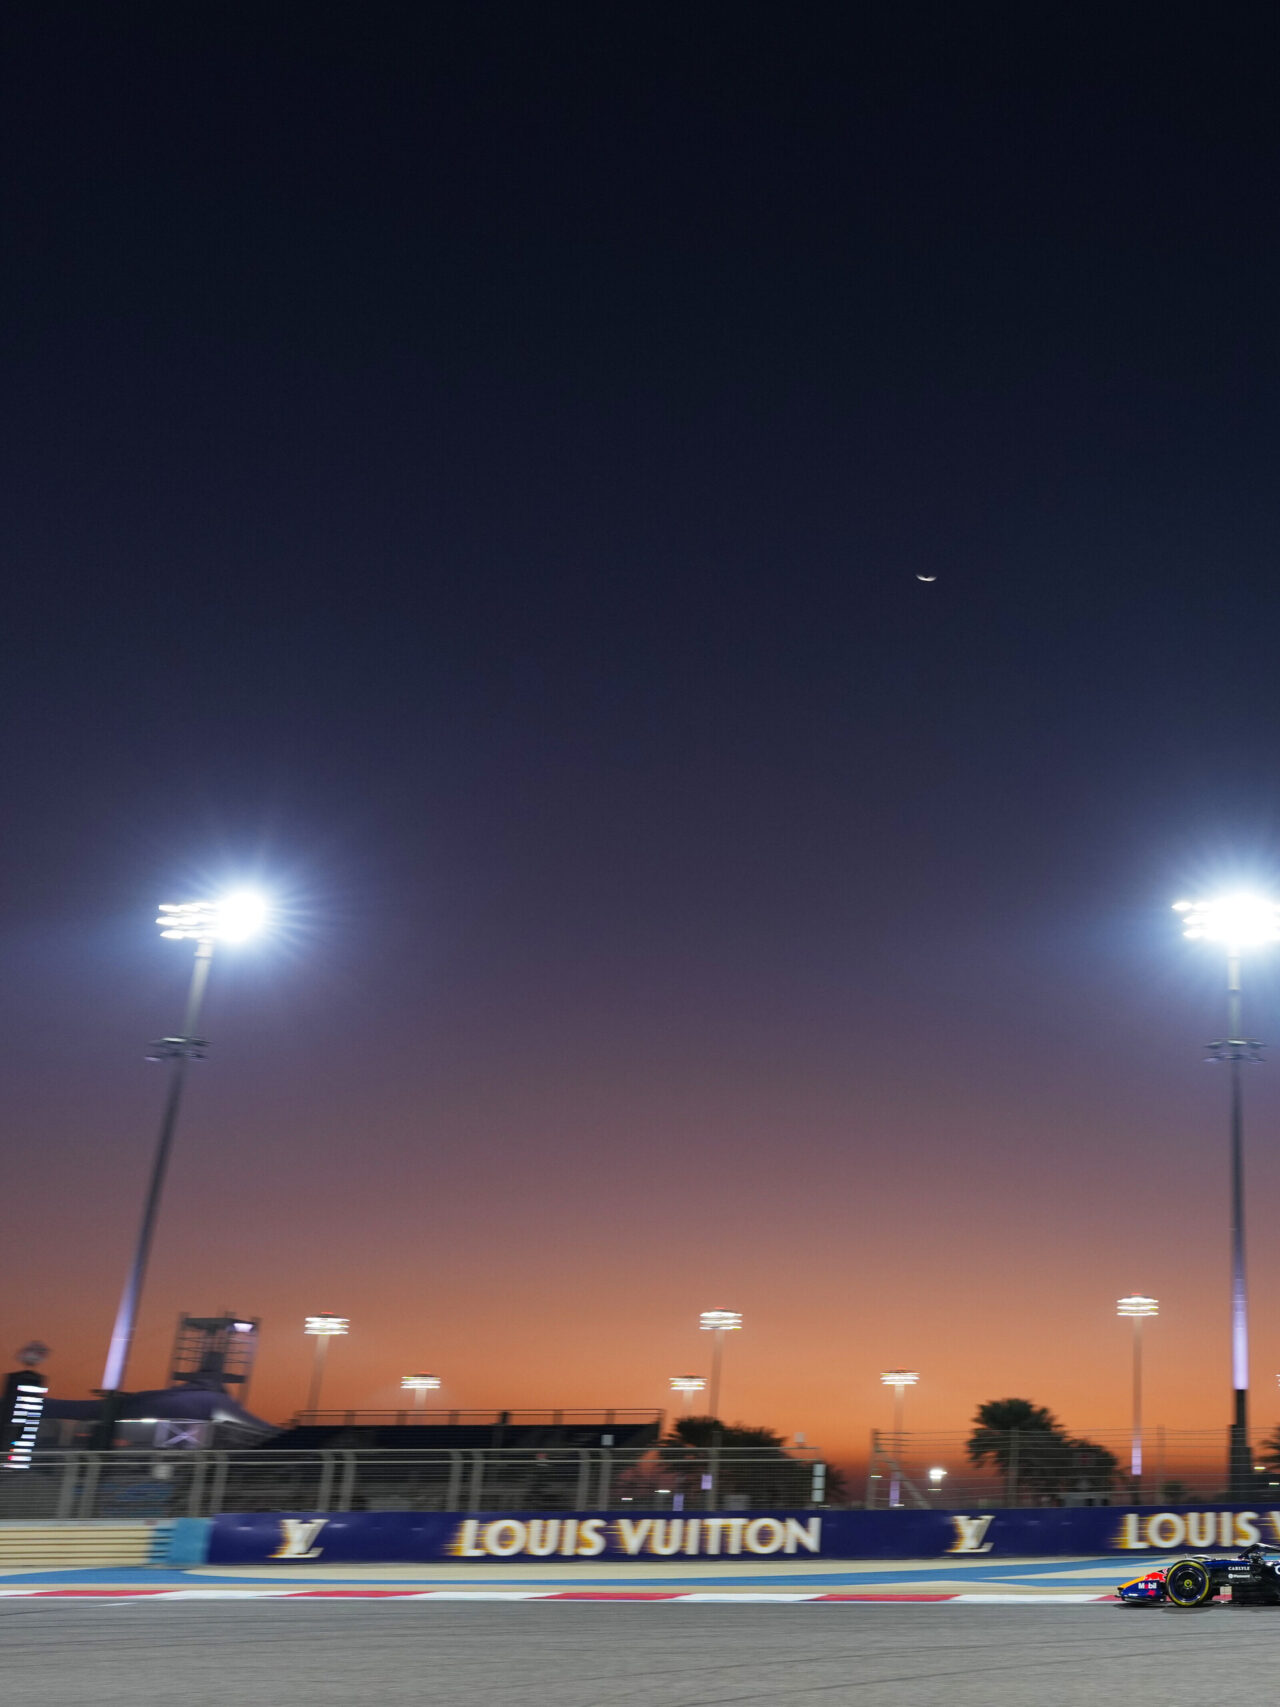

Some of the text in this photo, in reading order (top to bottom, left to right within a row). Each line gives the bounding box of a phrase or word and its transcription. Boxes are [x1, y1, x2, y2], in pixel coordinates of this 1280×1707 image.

[453, 1517, 821, 1556] LOUIS VUITTON
[1120, 1511, 1262, 1549] LOUIS
[1138, 1582, 1157, 1590] Mobil
